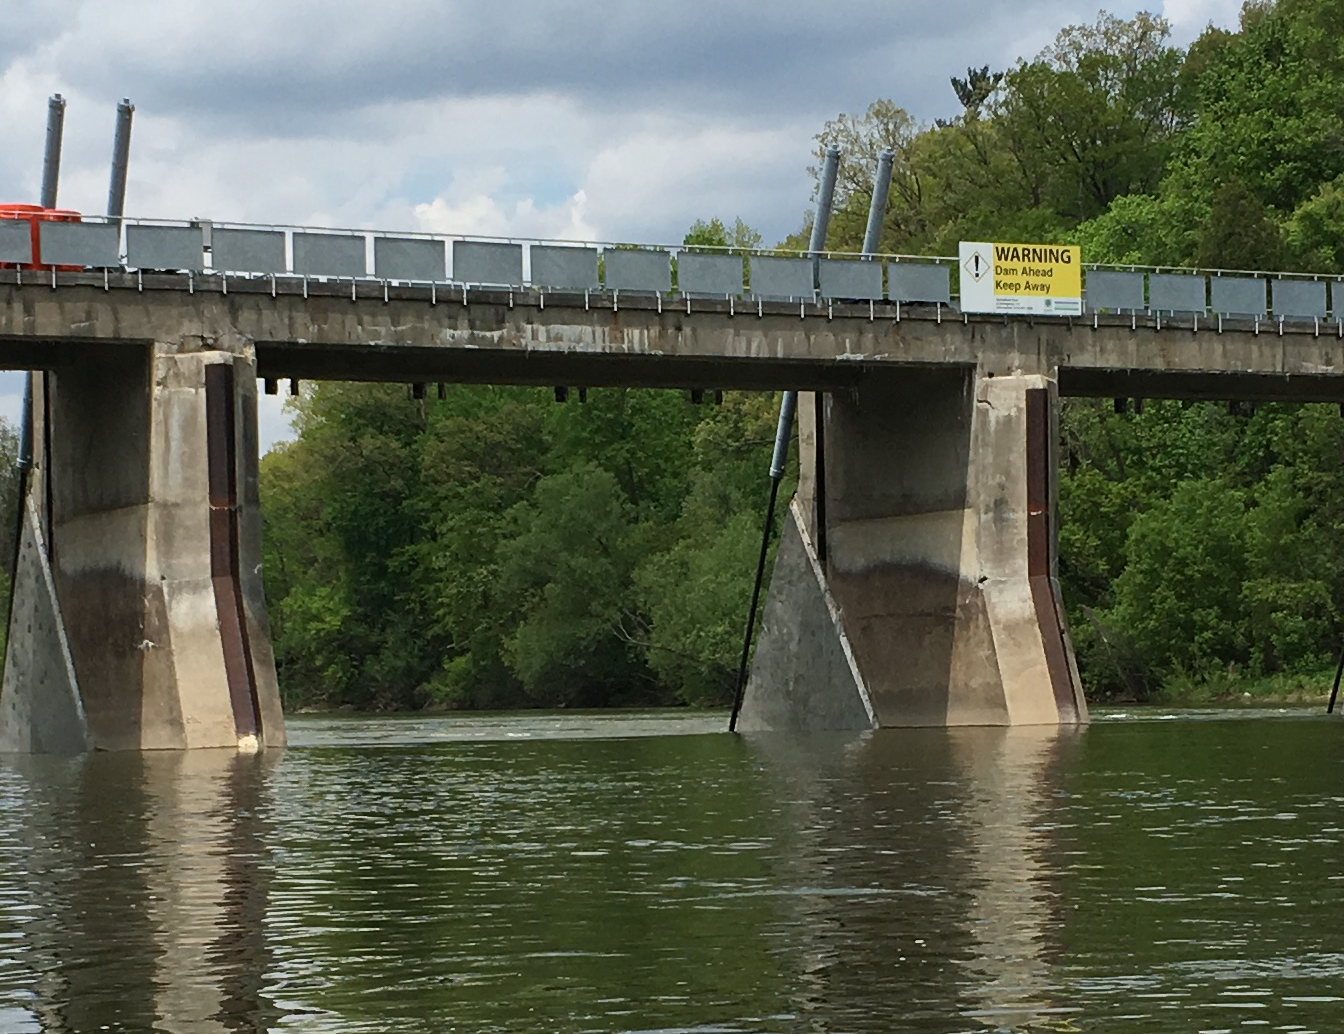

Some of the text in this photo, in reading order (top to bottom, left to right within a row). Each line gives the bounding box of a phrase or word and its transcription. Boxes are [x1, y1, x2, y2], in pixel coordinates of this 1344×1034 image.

[995, 246, 1071, 264] WARNING
[995, 265, 1053, 278] Dam Ahead
[995, 280, 1051, 294] Keep Away
